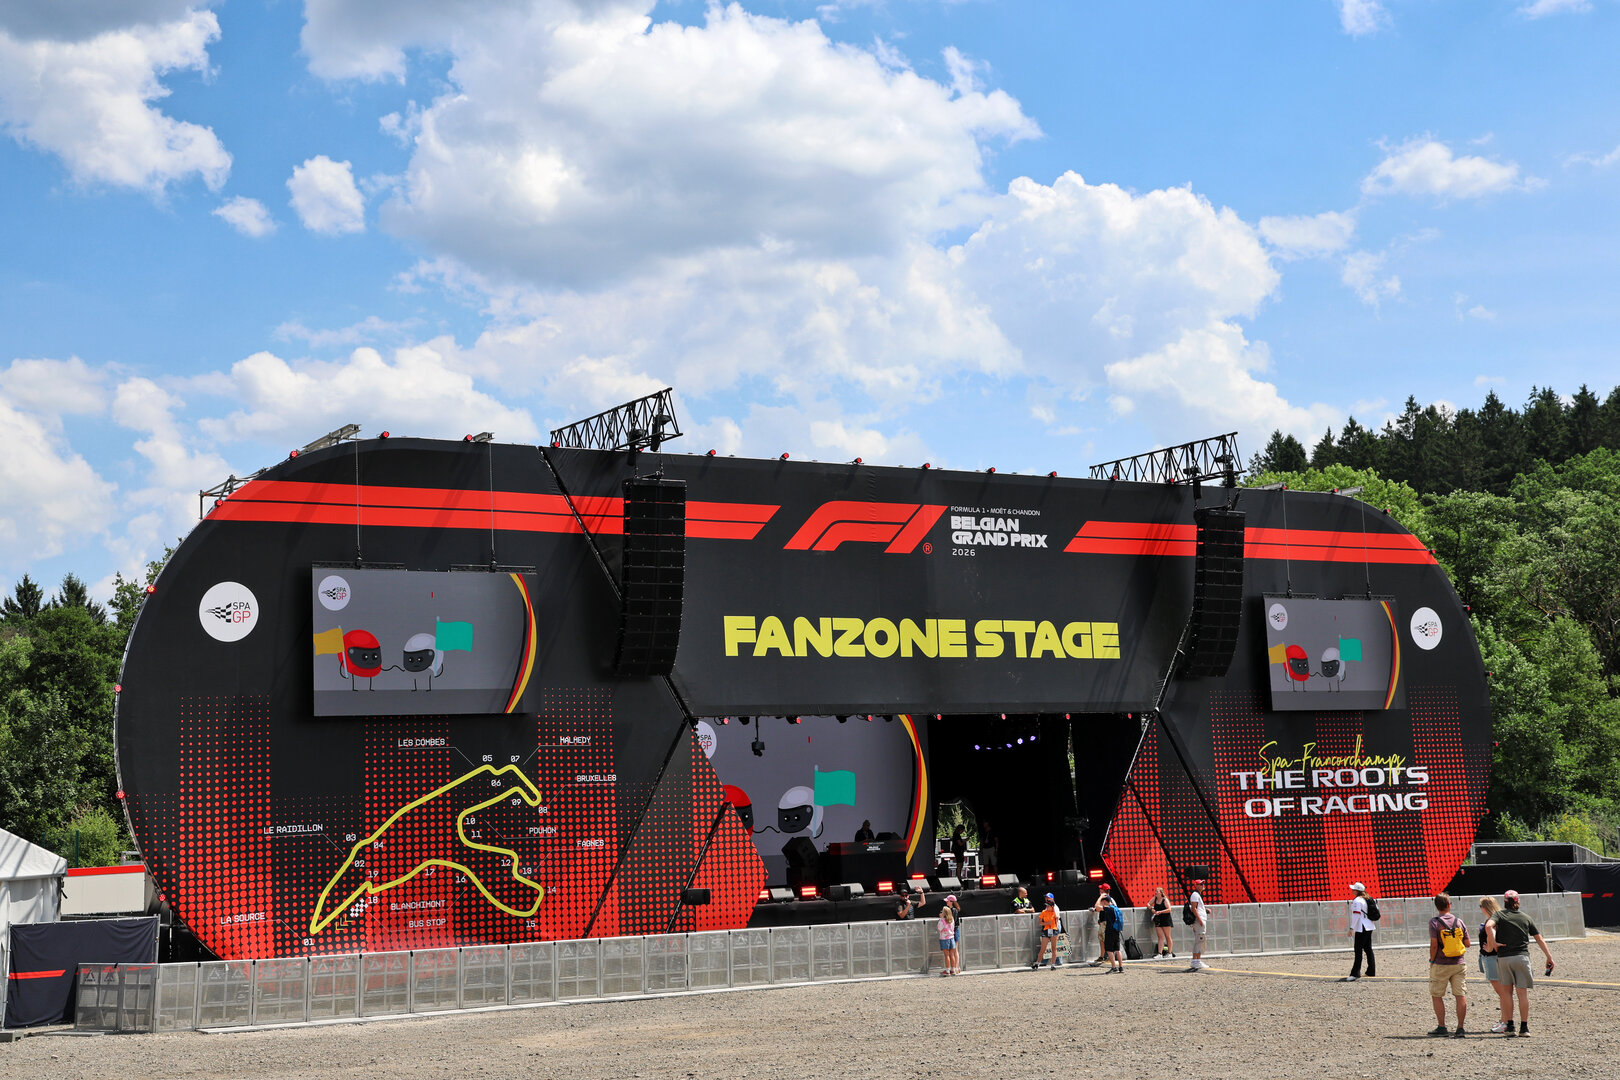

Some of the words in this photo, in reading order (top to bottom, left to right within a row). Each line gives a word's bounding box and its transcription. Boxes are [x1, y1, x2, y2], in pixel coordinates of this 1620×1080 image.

[951, 516, 1019, 532] BELGIAN
[952, 531, 1008, 546] GRAND
[1010, 533, 1048, 548] PRIX
[232, 602, 250, 610] SPA
[232, 611, 251, 623] GP
[724, 616, 968, 658] FANZONE
[974, 620, 1121, 659] STAGE
[1428, 627, 1438, 637] GP
[1230, 770, 1306, 790] THE
[1312, 766, 1429, 788] ROOTS
[1244, 797, 1294, 818] OF
[1301, 792, 1428, 816] RACING
[276, 824, 323, 833] RAIDILLON
[390, 900, 445, 911] BLANCHIMONT
[234, 912, 265, 922] SOURCE
[426, 919, 446, 927] STOP
